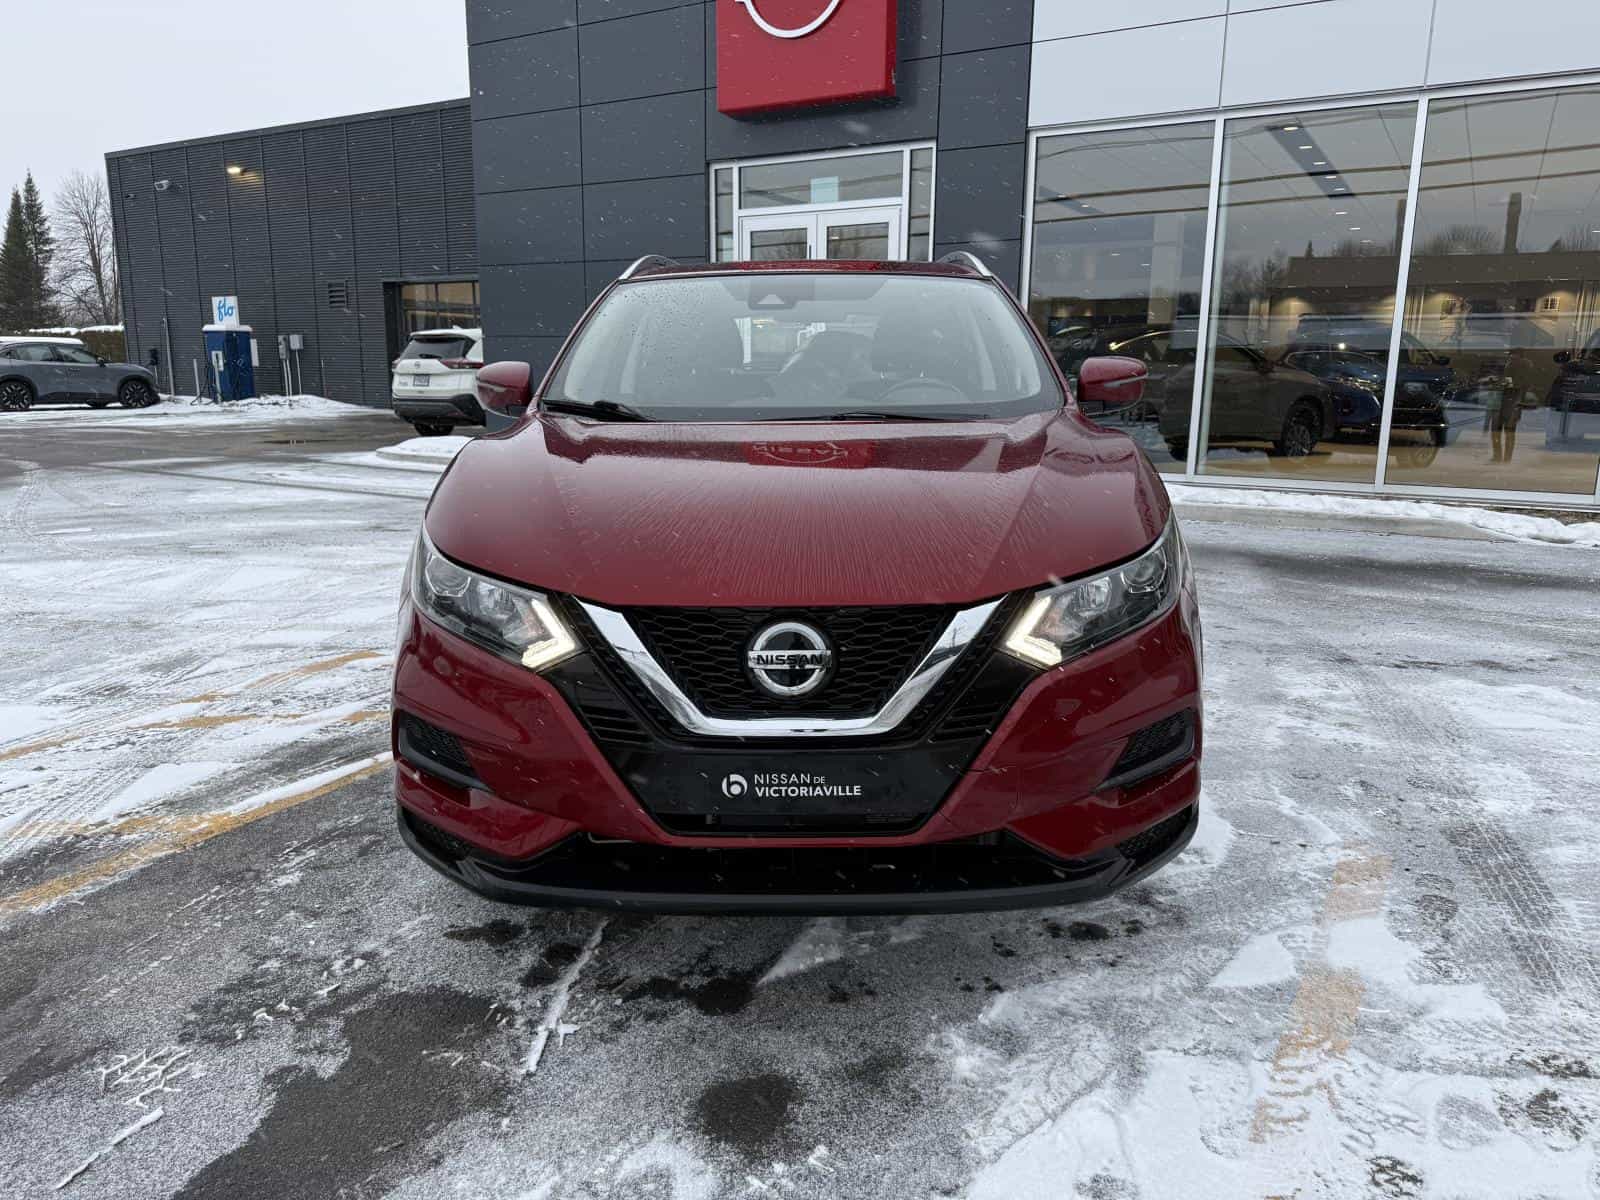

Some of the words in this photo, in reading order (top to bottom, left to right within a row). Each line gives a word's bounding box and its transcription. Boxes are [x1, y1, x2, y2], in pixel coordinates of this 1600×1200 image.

[217, 298, 234, 321] flo
[756, 654, 823, 665] NISSAN
[754, 773, 811, 785] NISSAN
[813, 776, 825, 784] DE
[755, 785, 862, 797] VICTORIAVILLE
